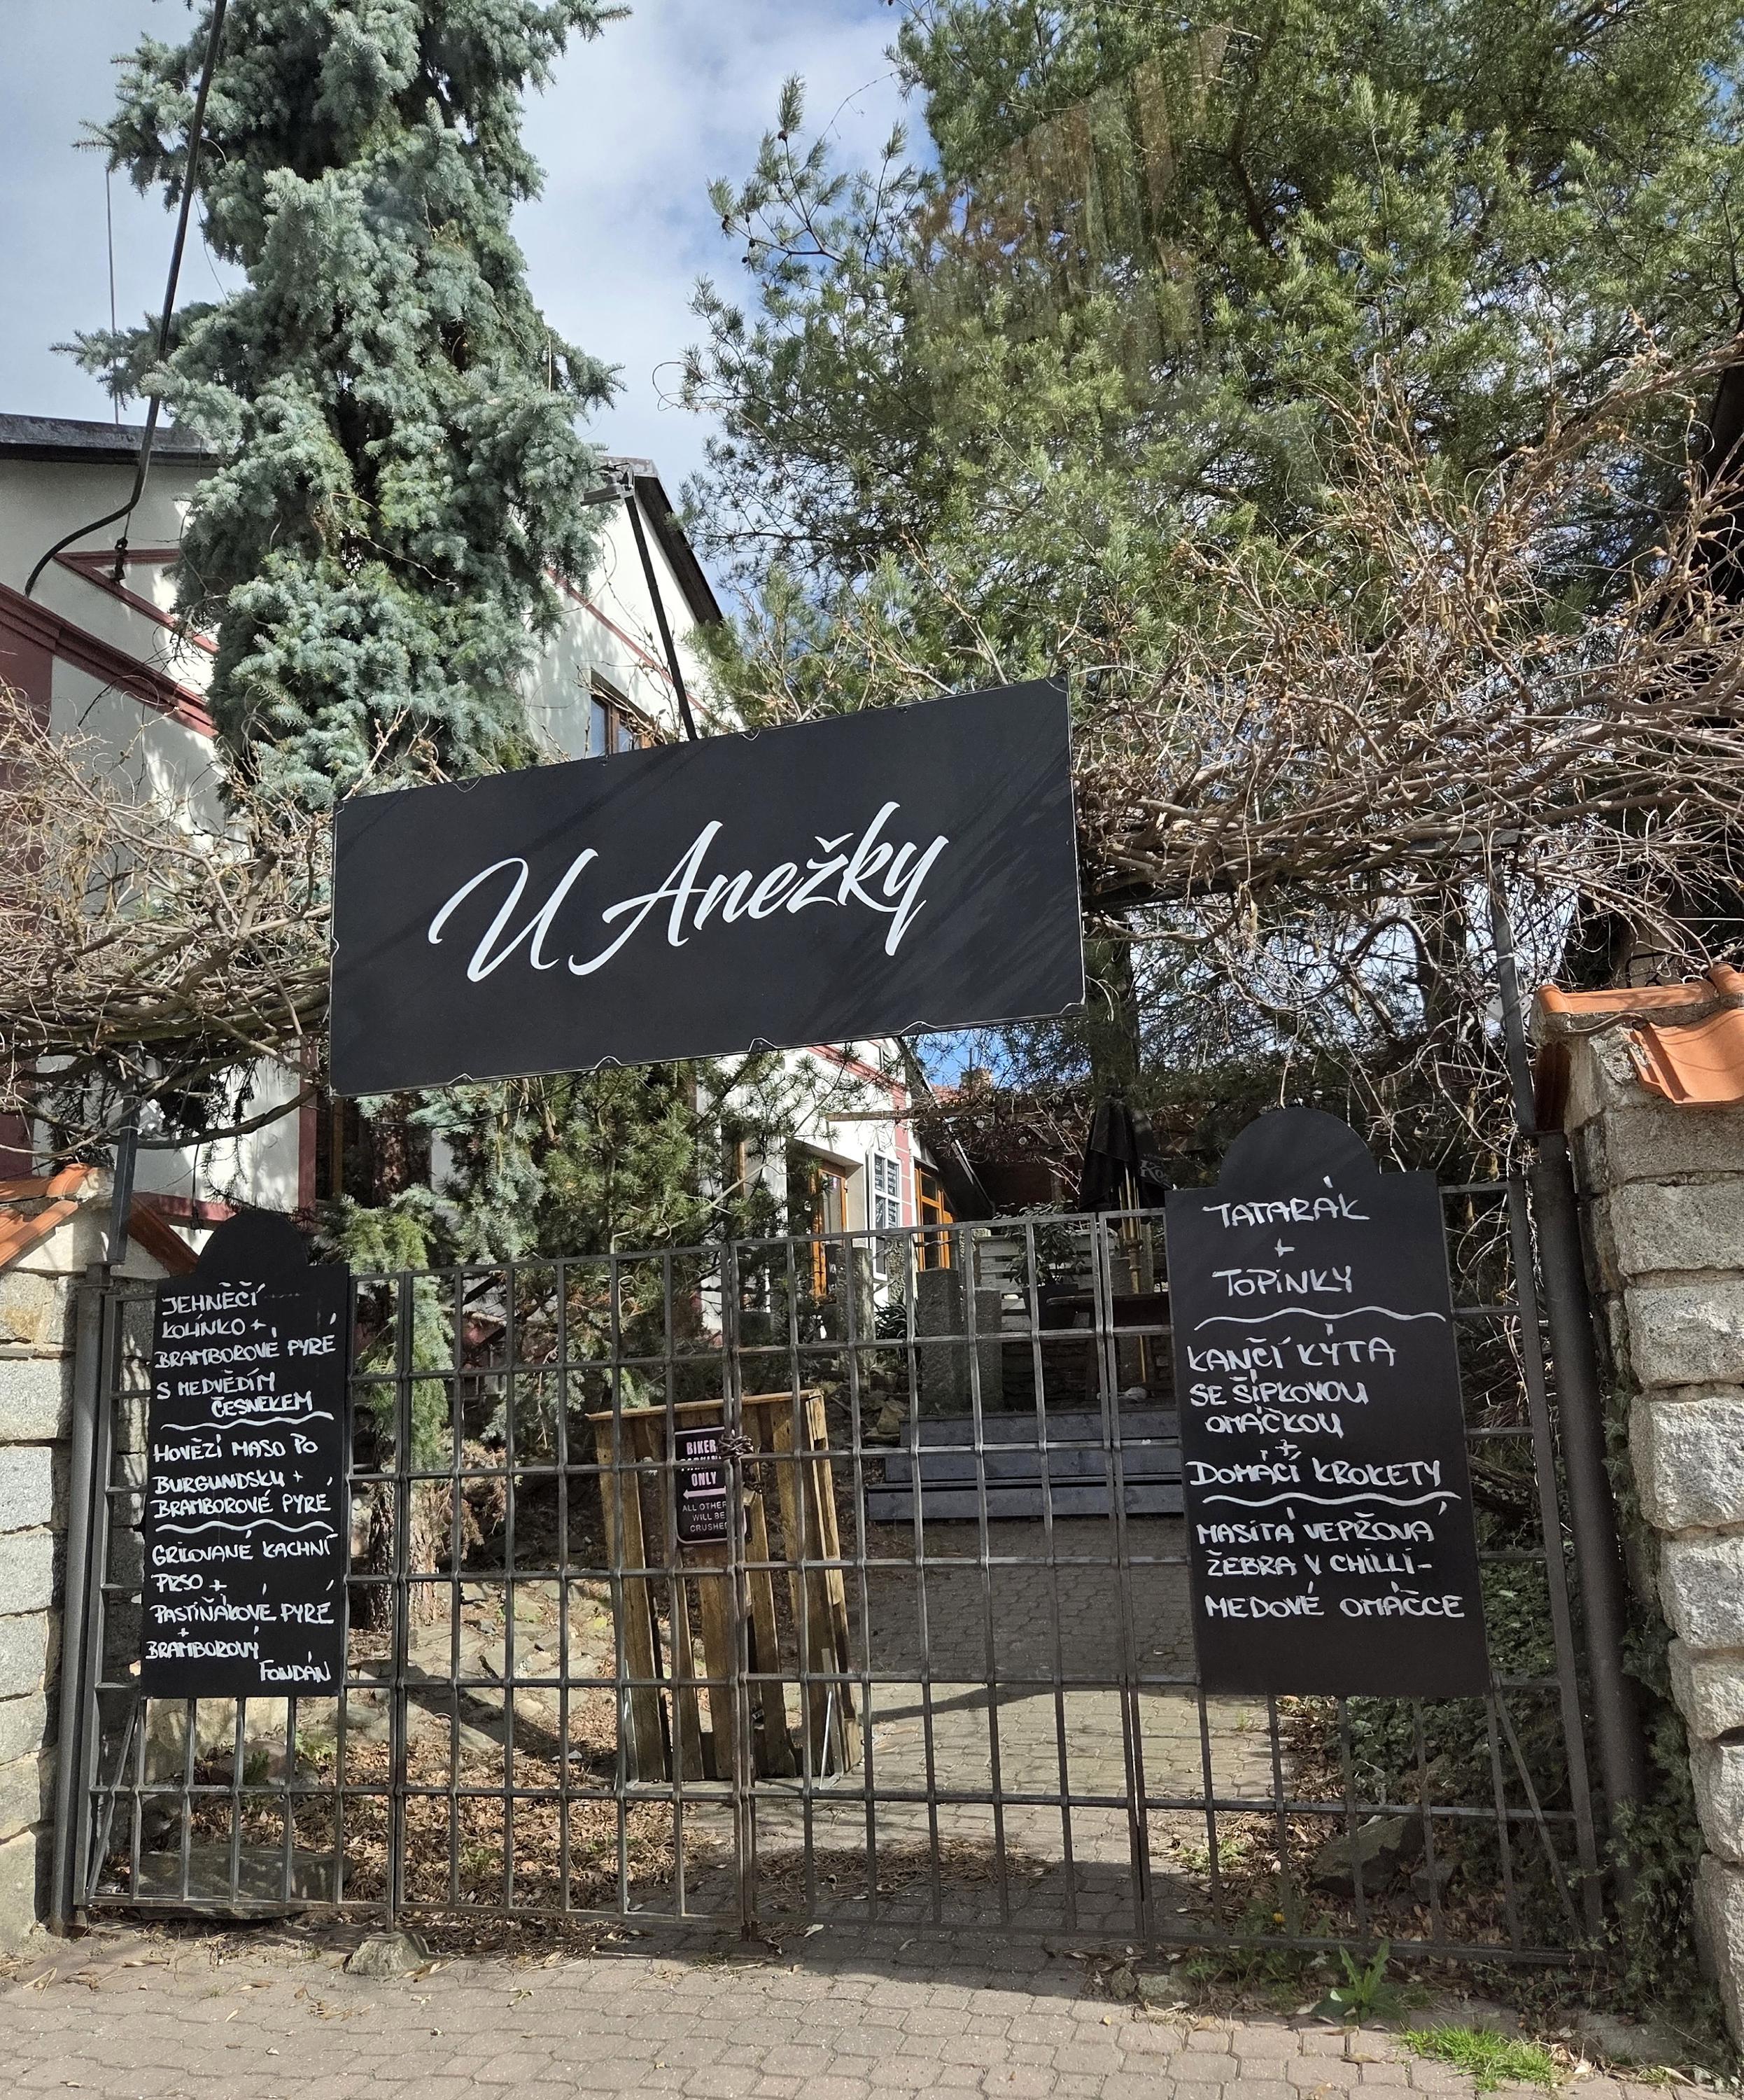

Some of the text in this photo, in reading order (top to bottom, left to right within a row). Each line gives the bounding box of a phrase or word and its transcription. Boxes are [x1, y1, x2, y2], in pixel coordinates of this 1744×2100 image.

[427, 801, 950, 983] U Anežky
[1202, 1175, 1370, 1228] TATARÁK
[162, 1281, 266, 1315] JEHNĚČÍ
[1211, 1265, 1352, 1297] TOPINKY
[154, 1312, 337, 1368] BRAMBOROVÉ PYRÉ
[162, 1313, 246, 1338] KOLÍNKO
[1187, 1323, 1397, 1372] KANČÍ KÝTA
[157, 1368, 276, 1399] S MEDVĚDÍM
[1189, 1368, 1370, 1407] SE ŠÍPKOVOU
[211, 1390, 313, 1418] ČESNEKEM
[1204, 1403, 1344, 1439] OMÁČKOU
[153, 1434, 223, 1462] HOVĚZÍ
[231, 1439, 286, 1457] MASO
[687, 1439, 716, 1455] BIKER
[151, 1469, 286, 1494] BURGUNDSKU
[691, 1471, 717, 1487] ONLY
[1185, 1450, 1440, 1488] DOMÁCÍ KROKETY
[150, 1476, 331, 1519] BRAMBOROVÉ PYRÉ
[692, 1511, 726, 1522] WILL BE
[1196, 1506, 1296, 1545] MASITÁ
[152, 1530, 338, 1567] GRILOVANÉ KACHNÍ
[1205, 1549, 1298, 1577] ŽEBRA
[1304, 1553, 1323, 1576] V
[151, 1574, 204, 1593] PRSO
[1204, 1580, 1465, 1618] MEDOVÉ OMÁČCE
[280, 1579, 335, 1624] PYRÉ
[145, 1625, 260, 1660] BRAMBOROVÝ
[259, 1650, 331, 1683] FONDÁN
